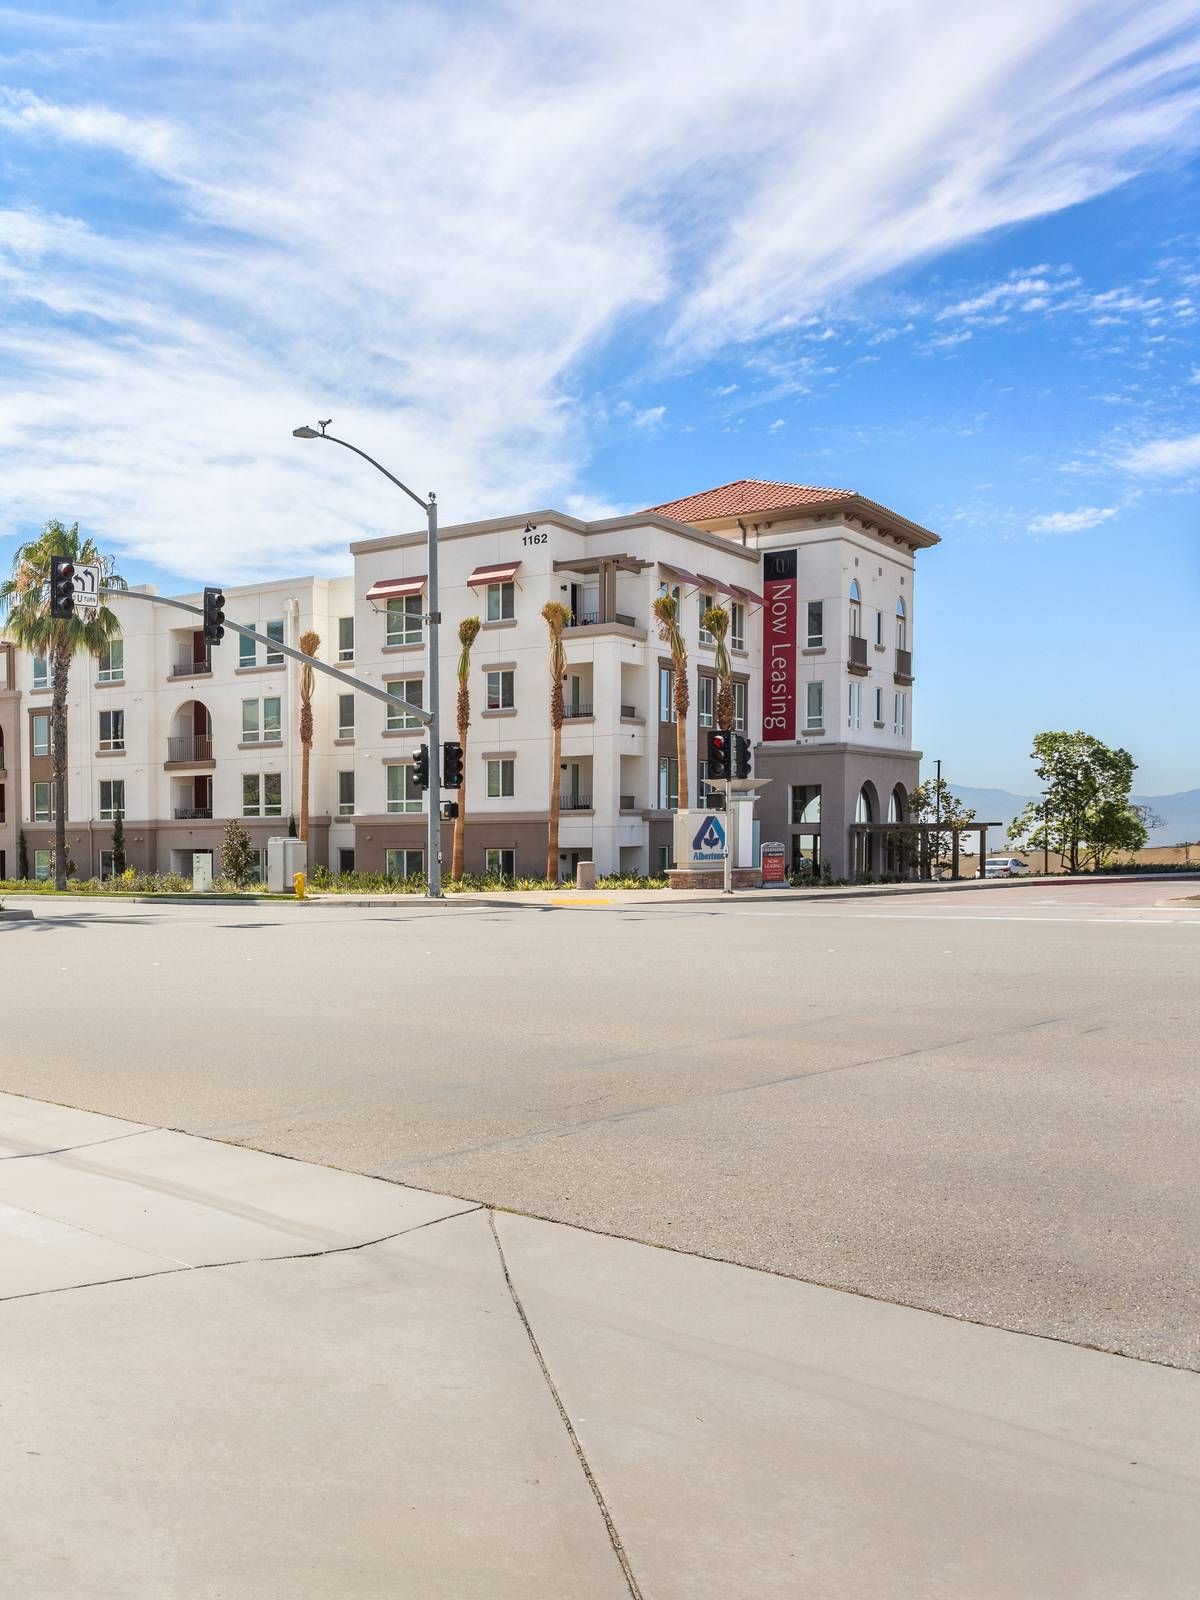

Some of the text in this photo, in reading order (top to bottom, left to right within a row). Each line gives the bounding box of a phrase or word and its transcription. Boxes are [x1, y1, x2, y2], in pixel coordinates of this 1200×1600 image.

[522, 533, 548, 546] 1162
[764, 583, 792, 730] Now Leasing
[693, 851, 726, 861] Albertson
